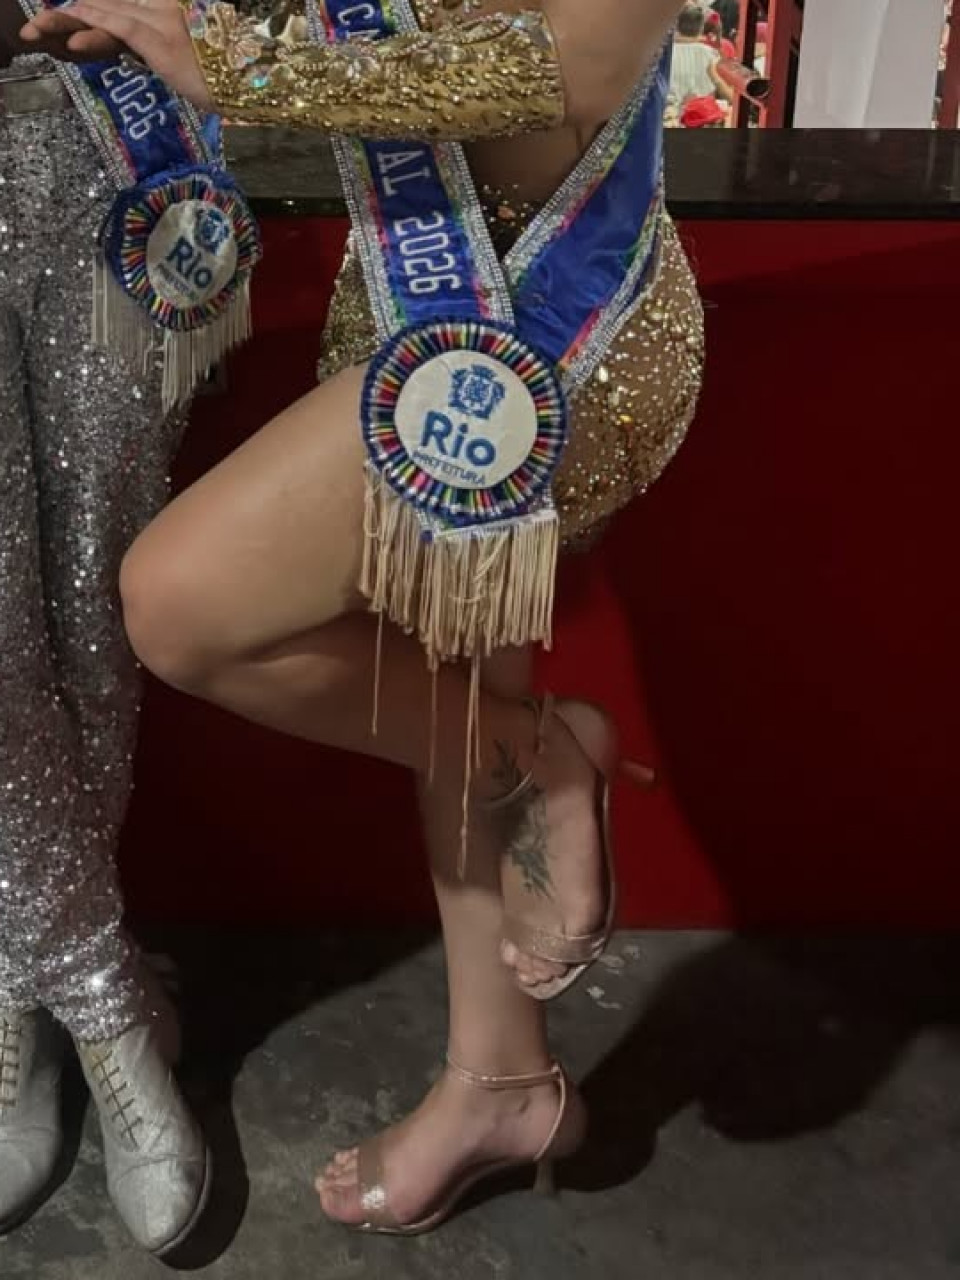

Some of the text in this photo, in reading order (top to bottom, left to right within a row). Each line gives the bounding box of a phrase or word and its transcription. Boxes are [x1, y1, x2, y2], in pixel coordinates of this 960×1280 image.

[100, 64, 167, 140] 2026
[165, 236, 213, 289] Rio
[394, 211, 462, 295] 2026
[421, 410, 496, 468] Rio
